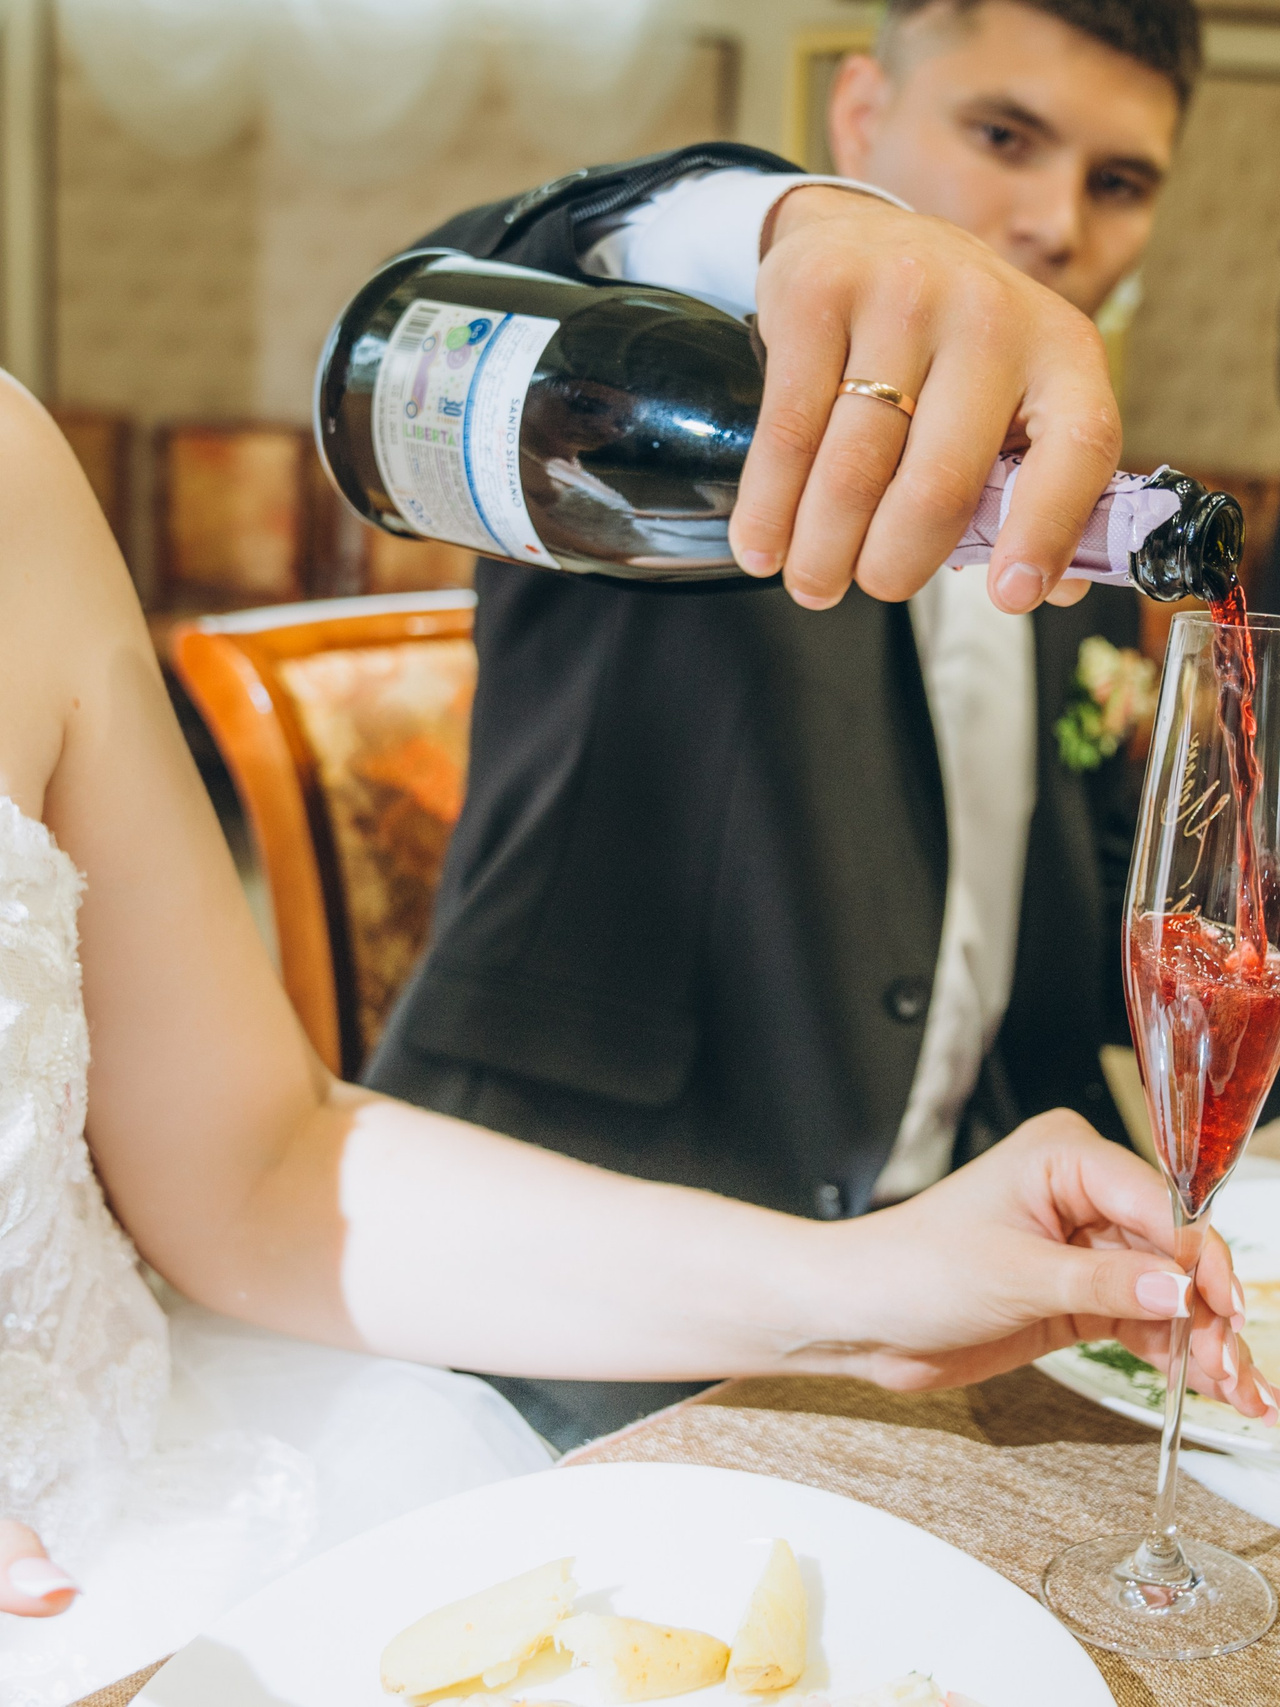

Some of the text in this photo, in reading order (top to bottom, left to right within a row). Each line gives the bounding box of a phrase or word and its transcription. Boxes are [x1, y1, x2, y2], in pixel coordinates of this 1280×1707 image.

[443, 397, 464, 417] 30
[506, 398, 522, 508] SANTO STEFANO
